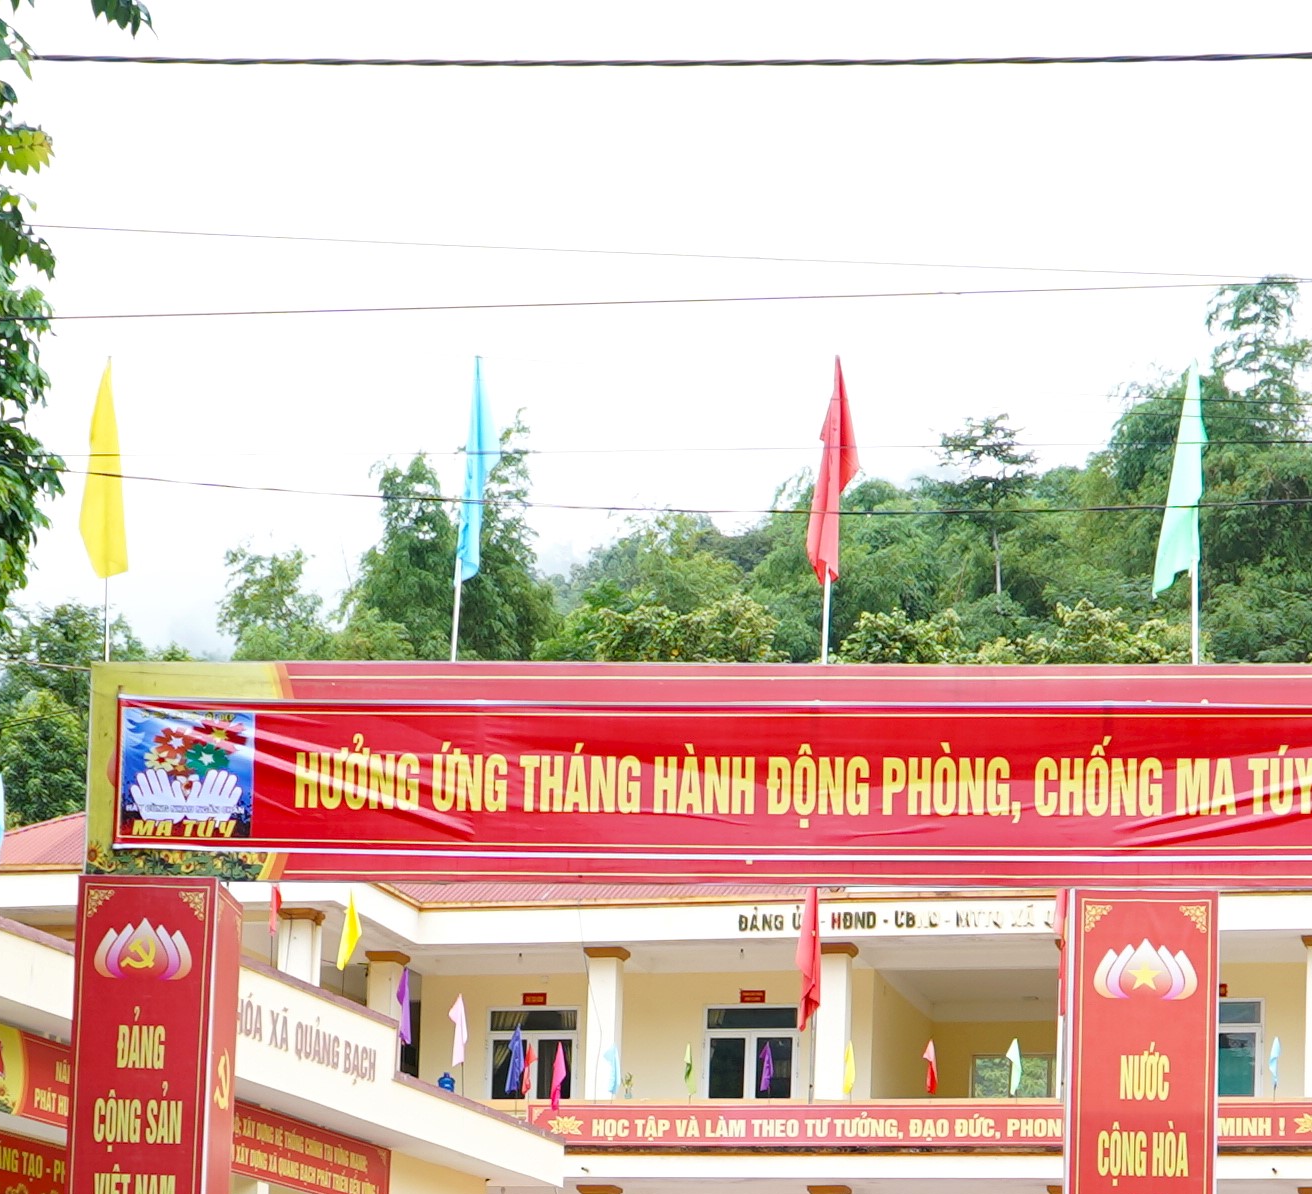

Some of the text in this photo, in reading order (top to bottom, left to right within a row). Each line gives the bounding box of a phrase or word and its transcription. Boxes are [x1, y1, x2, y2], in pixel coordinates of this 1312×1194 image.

[295, 734, 420, 812] HƯỞNG
[432, 741, 508, 812] ỨNG
[520, 742, 641, 814] THÁNG
[655, 743, 756, 815] HÀNH
[767, 743, 869, 828] ĐỘNG
[882, 742, 1020, 824] PHÒNG,
[1035, 736, 1163, 817] CHỐNG
[1176, 757, 1235, 816] MA
[132, 816, 237, 838] MA TÚY
[738, 906, 784, 931] ĐẢNG
[831, 911, 876, 930] HĐND
[117, 1006, 164, 1070] ĐẢNG
[269, 1007, 289, 1052] XÃ
[295, 1016, 340, 1070] QUẢNG
[343, 1040, 376, 1085] BẠCH
[34, 1087, 56, 1112] PHÁT
[1119, 1041, 1170, 1101] NƯỚC
[93, 1091, 140, 1152] CỘNG
[146, 1084, 182, 1145] SẢN
[592, 1118, 629, 1140] HỌC
[634, 1115, 670, 1141] TẬP
[675, 1116, 700, 1137] VÀ
[705, 1116, 746, 1137] LÀM
[751, 1119, 799, 1137] THEO
[805, 1117, 831, 1137] TƯ
[834, 1111, 903, 1139] TƯỞNG,
[908, 1118, 949, 1141] ĐẠO
[954, 1113, 1001, 1140] ĐỨC,
[1006, 1118, 1064, 1138] PHON
[1218, 1117, 1272, 1136] MINH
[22, 1151, 43, 1182] TẠO
[1097, 1120, 1189, 1186] CỘNG HÒA
